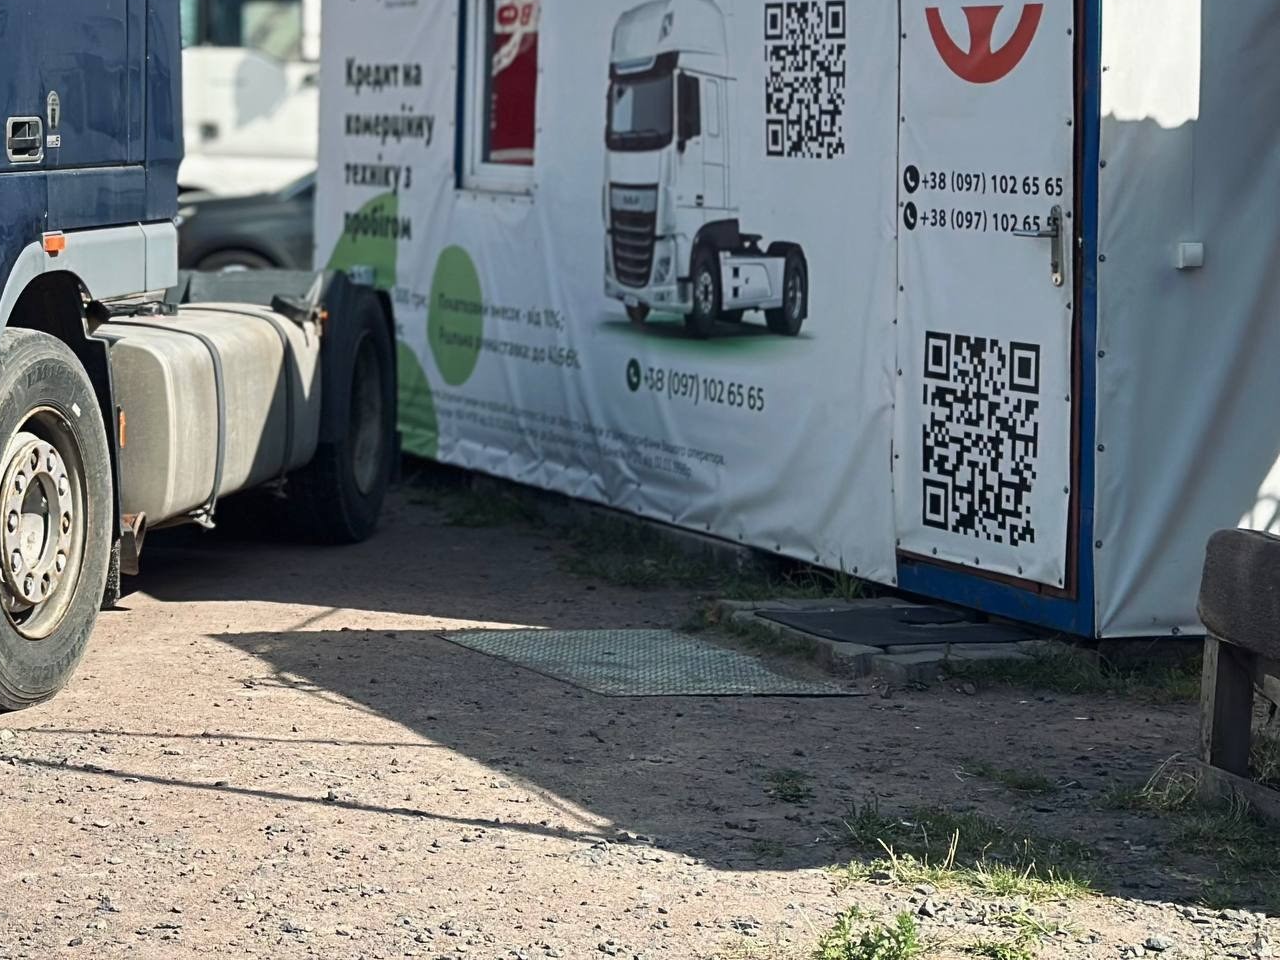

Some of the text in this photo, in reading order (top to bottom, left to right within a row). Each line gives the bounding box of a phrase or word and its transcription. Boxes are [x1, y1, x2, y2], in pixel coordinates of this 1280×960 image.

[345, 56, 422, 95] Кредит на
[345, 103, 435, 147] комерційну
[344, 152, 402, 197] техніку
[921, 170, 1064, 197] +38 (097) 102 65 65
[344, 203, 412, 243] пробігом
[920, 208, 947, 228] +38
[950, 207, 987, 233] (097)
[992, 213, 1017, 233] 102
[1022, 215, 1041, 231] 65
[644, 366, 765, 412] +38 (097) 102 65 65
